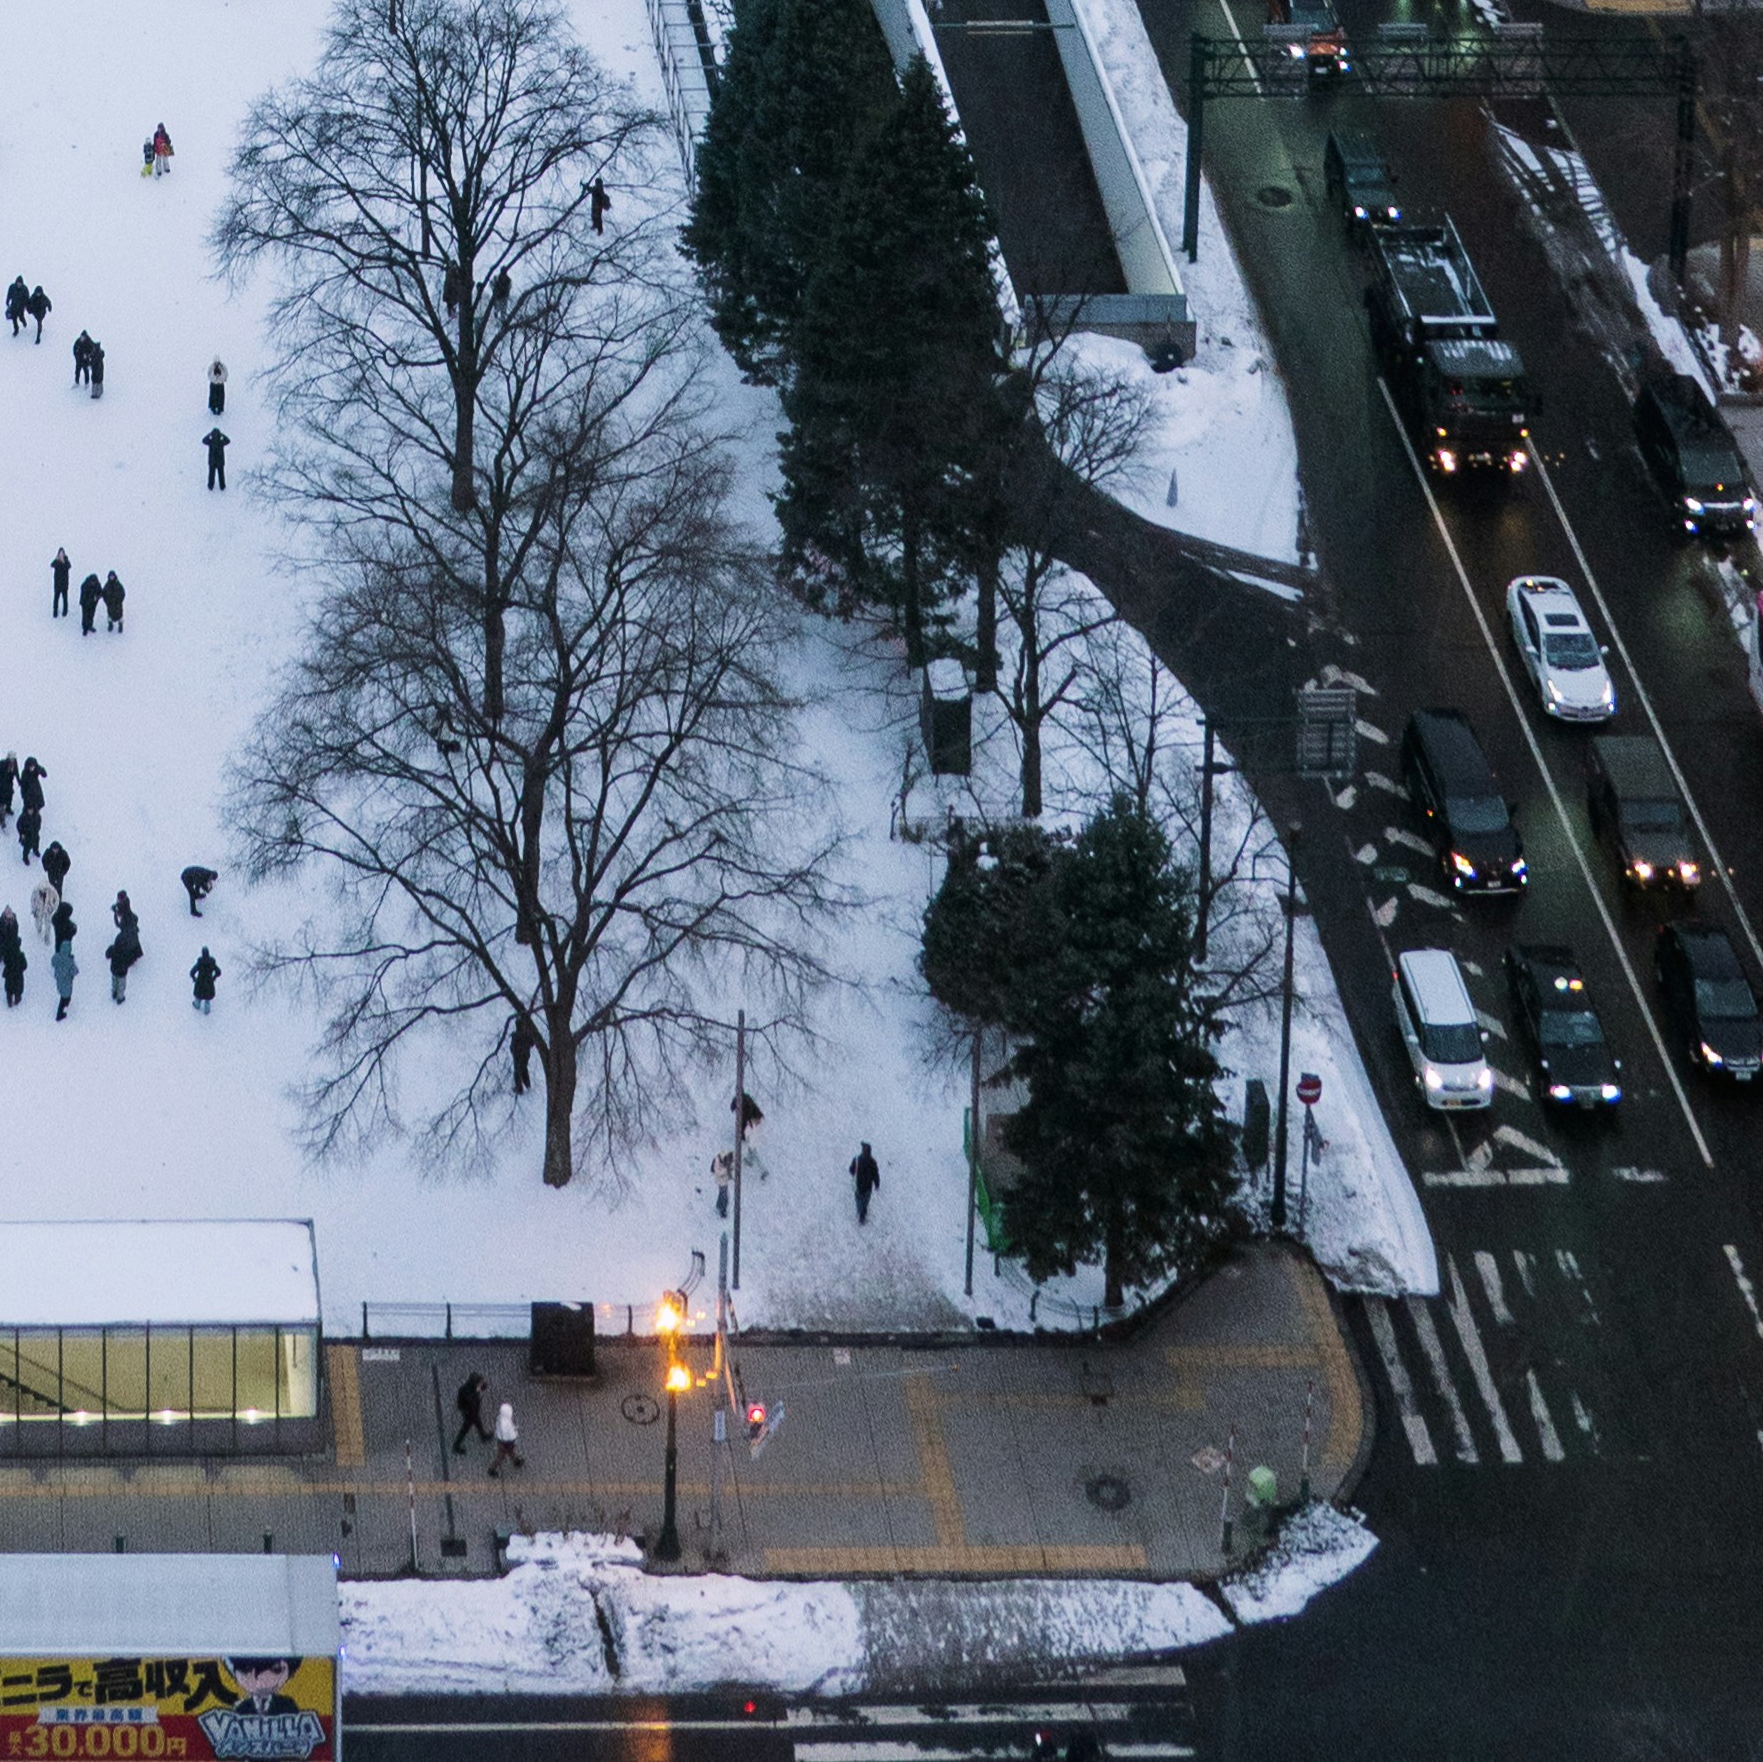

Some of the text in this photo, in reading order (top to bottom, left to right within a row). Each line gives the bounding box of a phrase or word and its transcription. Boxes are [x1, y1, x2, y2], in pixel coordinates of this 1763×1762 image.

[56, 1707, 143, 1722] 業界最高額
